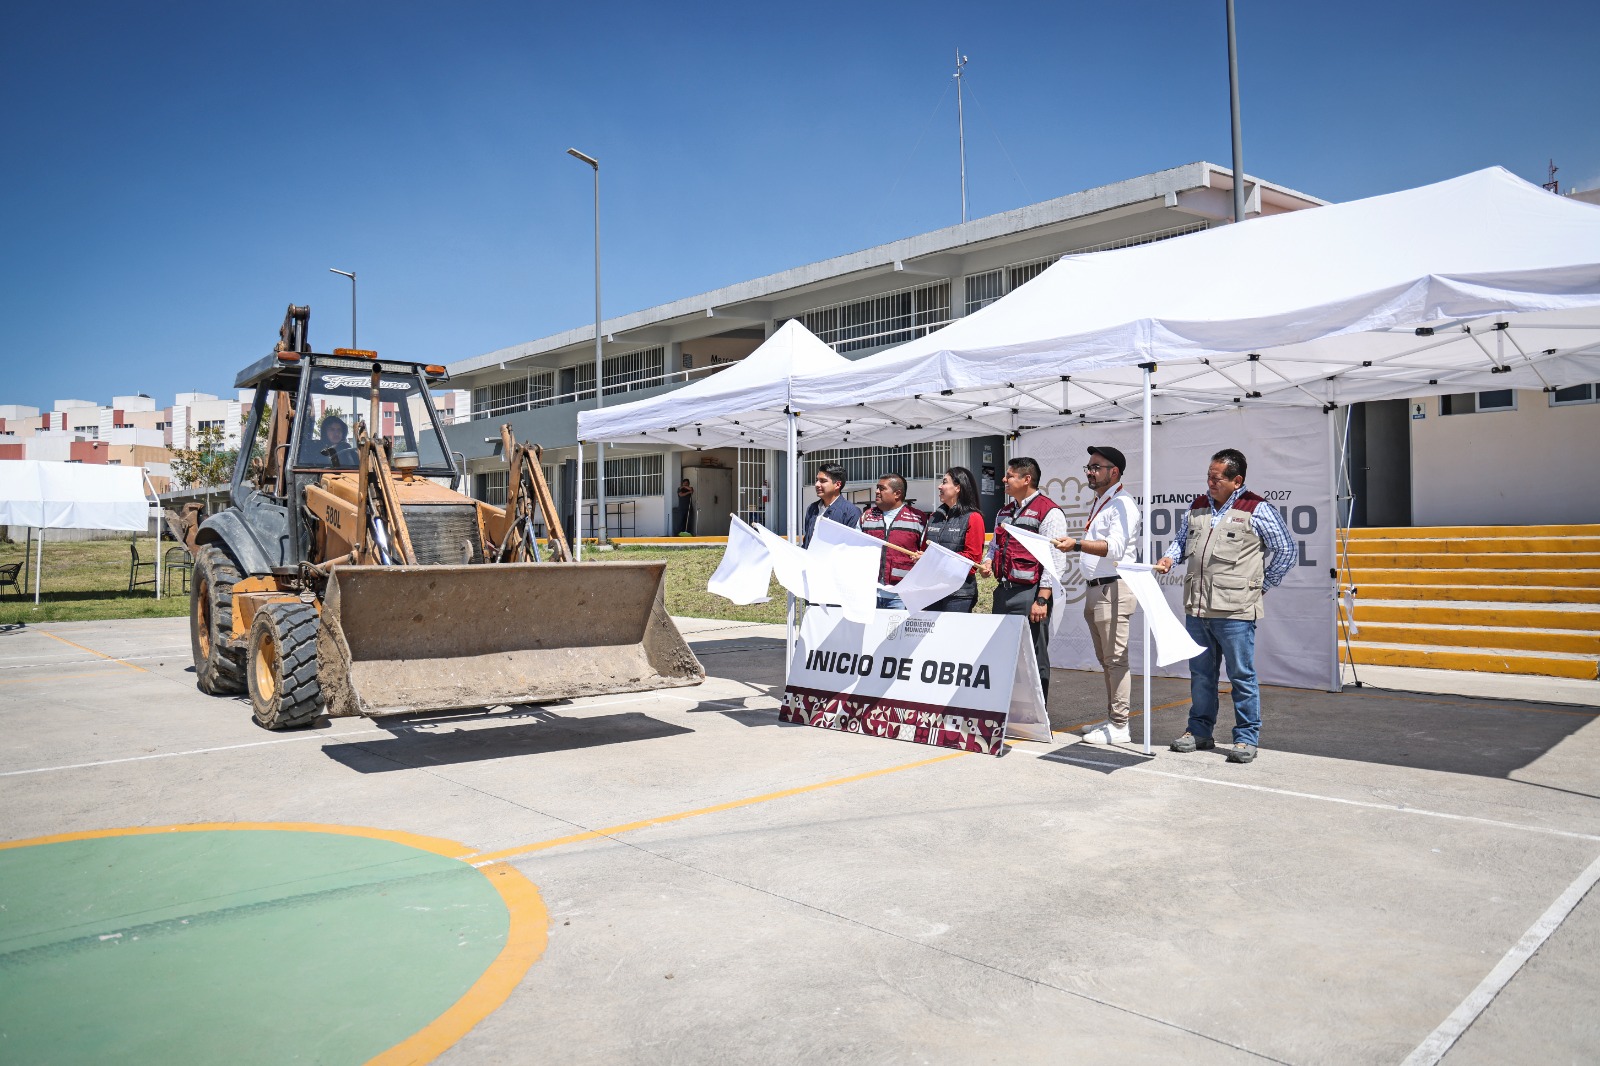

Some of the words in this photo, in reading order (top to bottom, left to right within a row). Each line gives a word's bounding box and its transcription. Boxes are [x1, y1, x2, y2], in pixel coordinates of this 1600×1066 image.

[1263, 490, 1292, 501] 2027
[325, 504, 342, 530] 580L
[805, 649, 874, 677] INICIO
[879, 656, 913, 681] DE
[920, 660, 991, 690] OBRA
